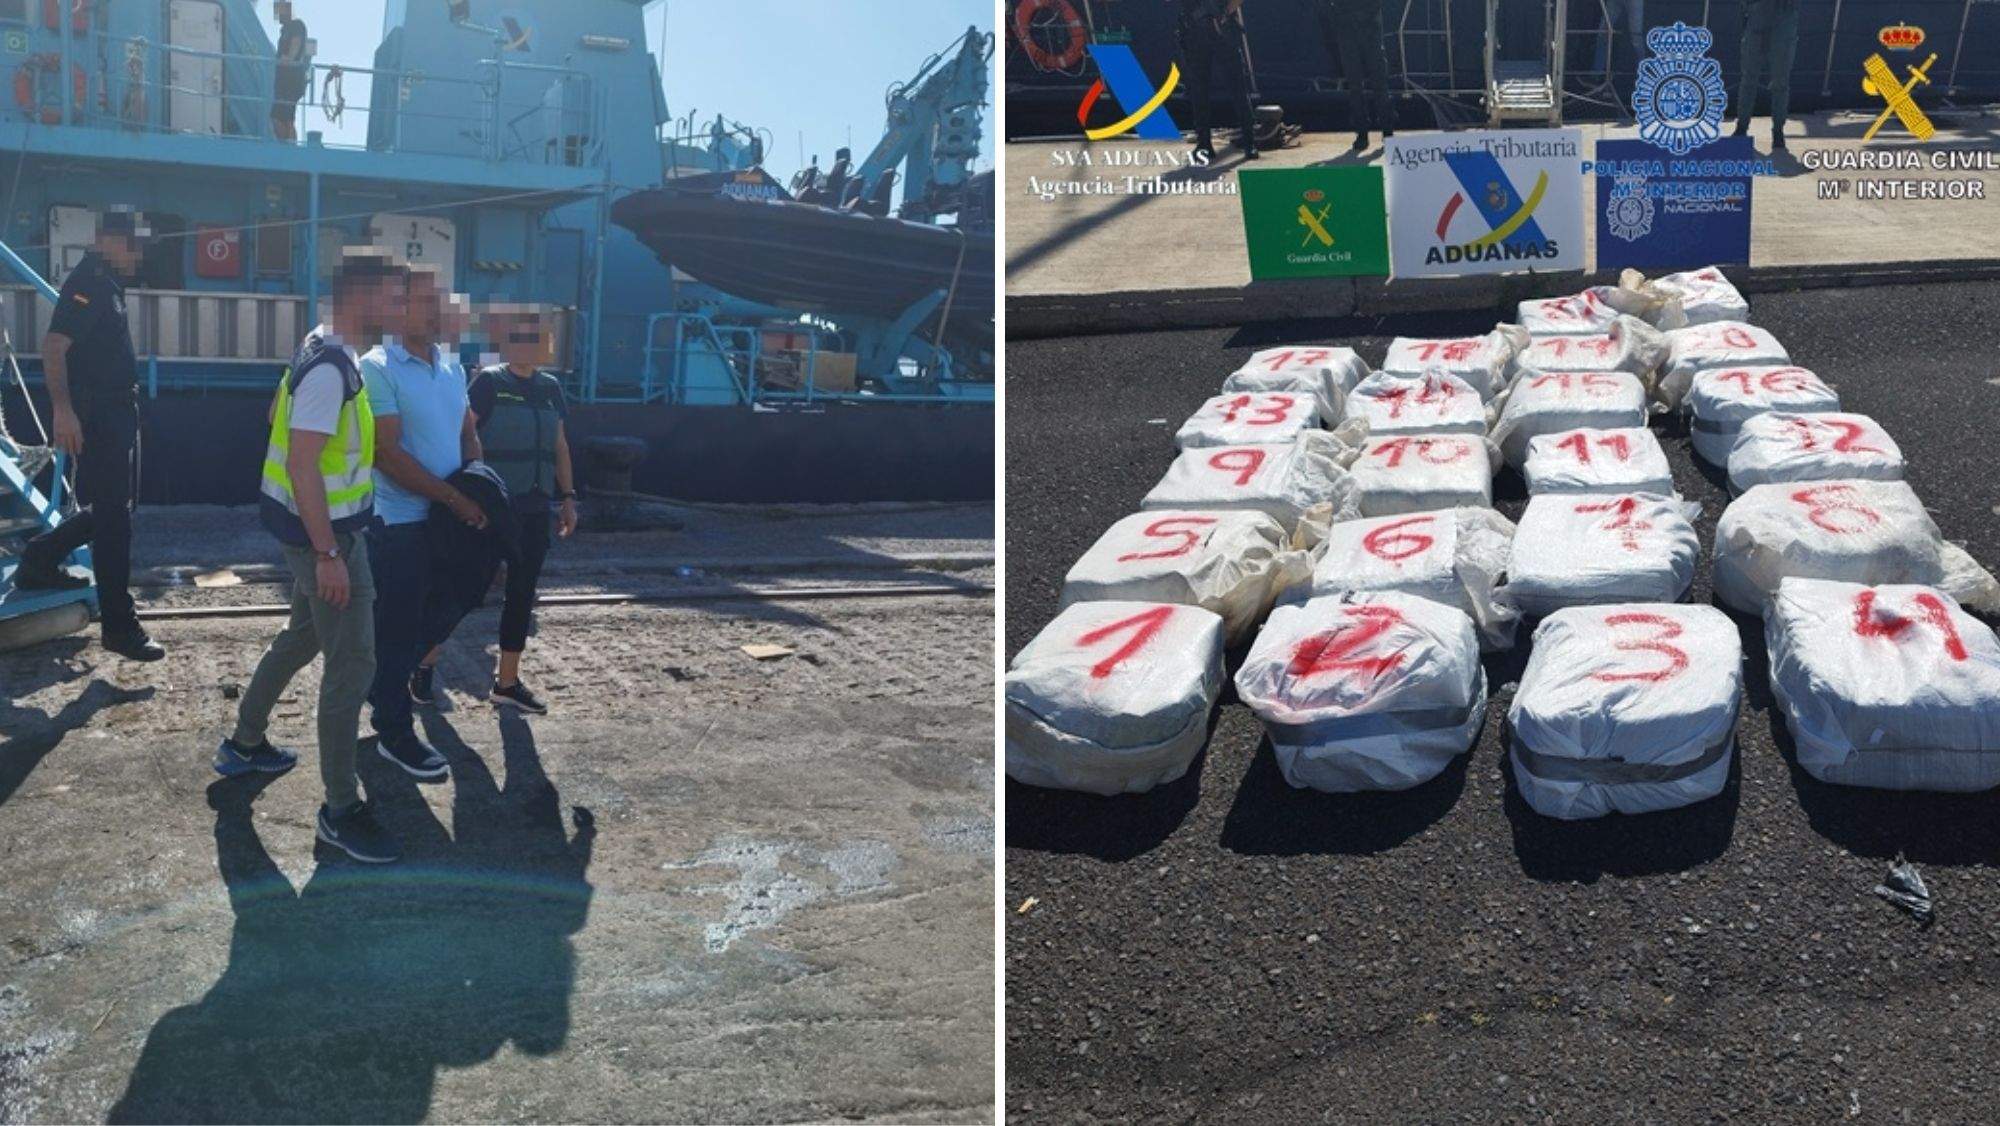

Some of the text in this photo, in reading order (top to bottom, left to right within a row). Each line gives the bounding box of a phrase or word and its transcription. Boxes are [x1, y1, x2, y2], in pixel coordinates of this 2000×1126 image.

[1391, 136, 1577, 171] Agencia Tributaria
[1663, 201, 1743, 214] NACIONAL
[1287, 251, 1352, 264] Guardia Civil
[1425, 239, 1559, 266] ADUANAS
[1217, 395, 1294, 426] 13
[1371, 437, 1471, 468] 10
[1556, 433, 1630, 465] 11
[1209, 449, 1266, 486] 9
[1117, 516, 1218, 563] 5
[1363, 516, 1437, 562] 6
[1075, 605, 1176, 678] 1
[1589, 613, 1690, 682] 3
